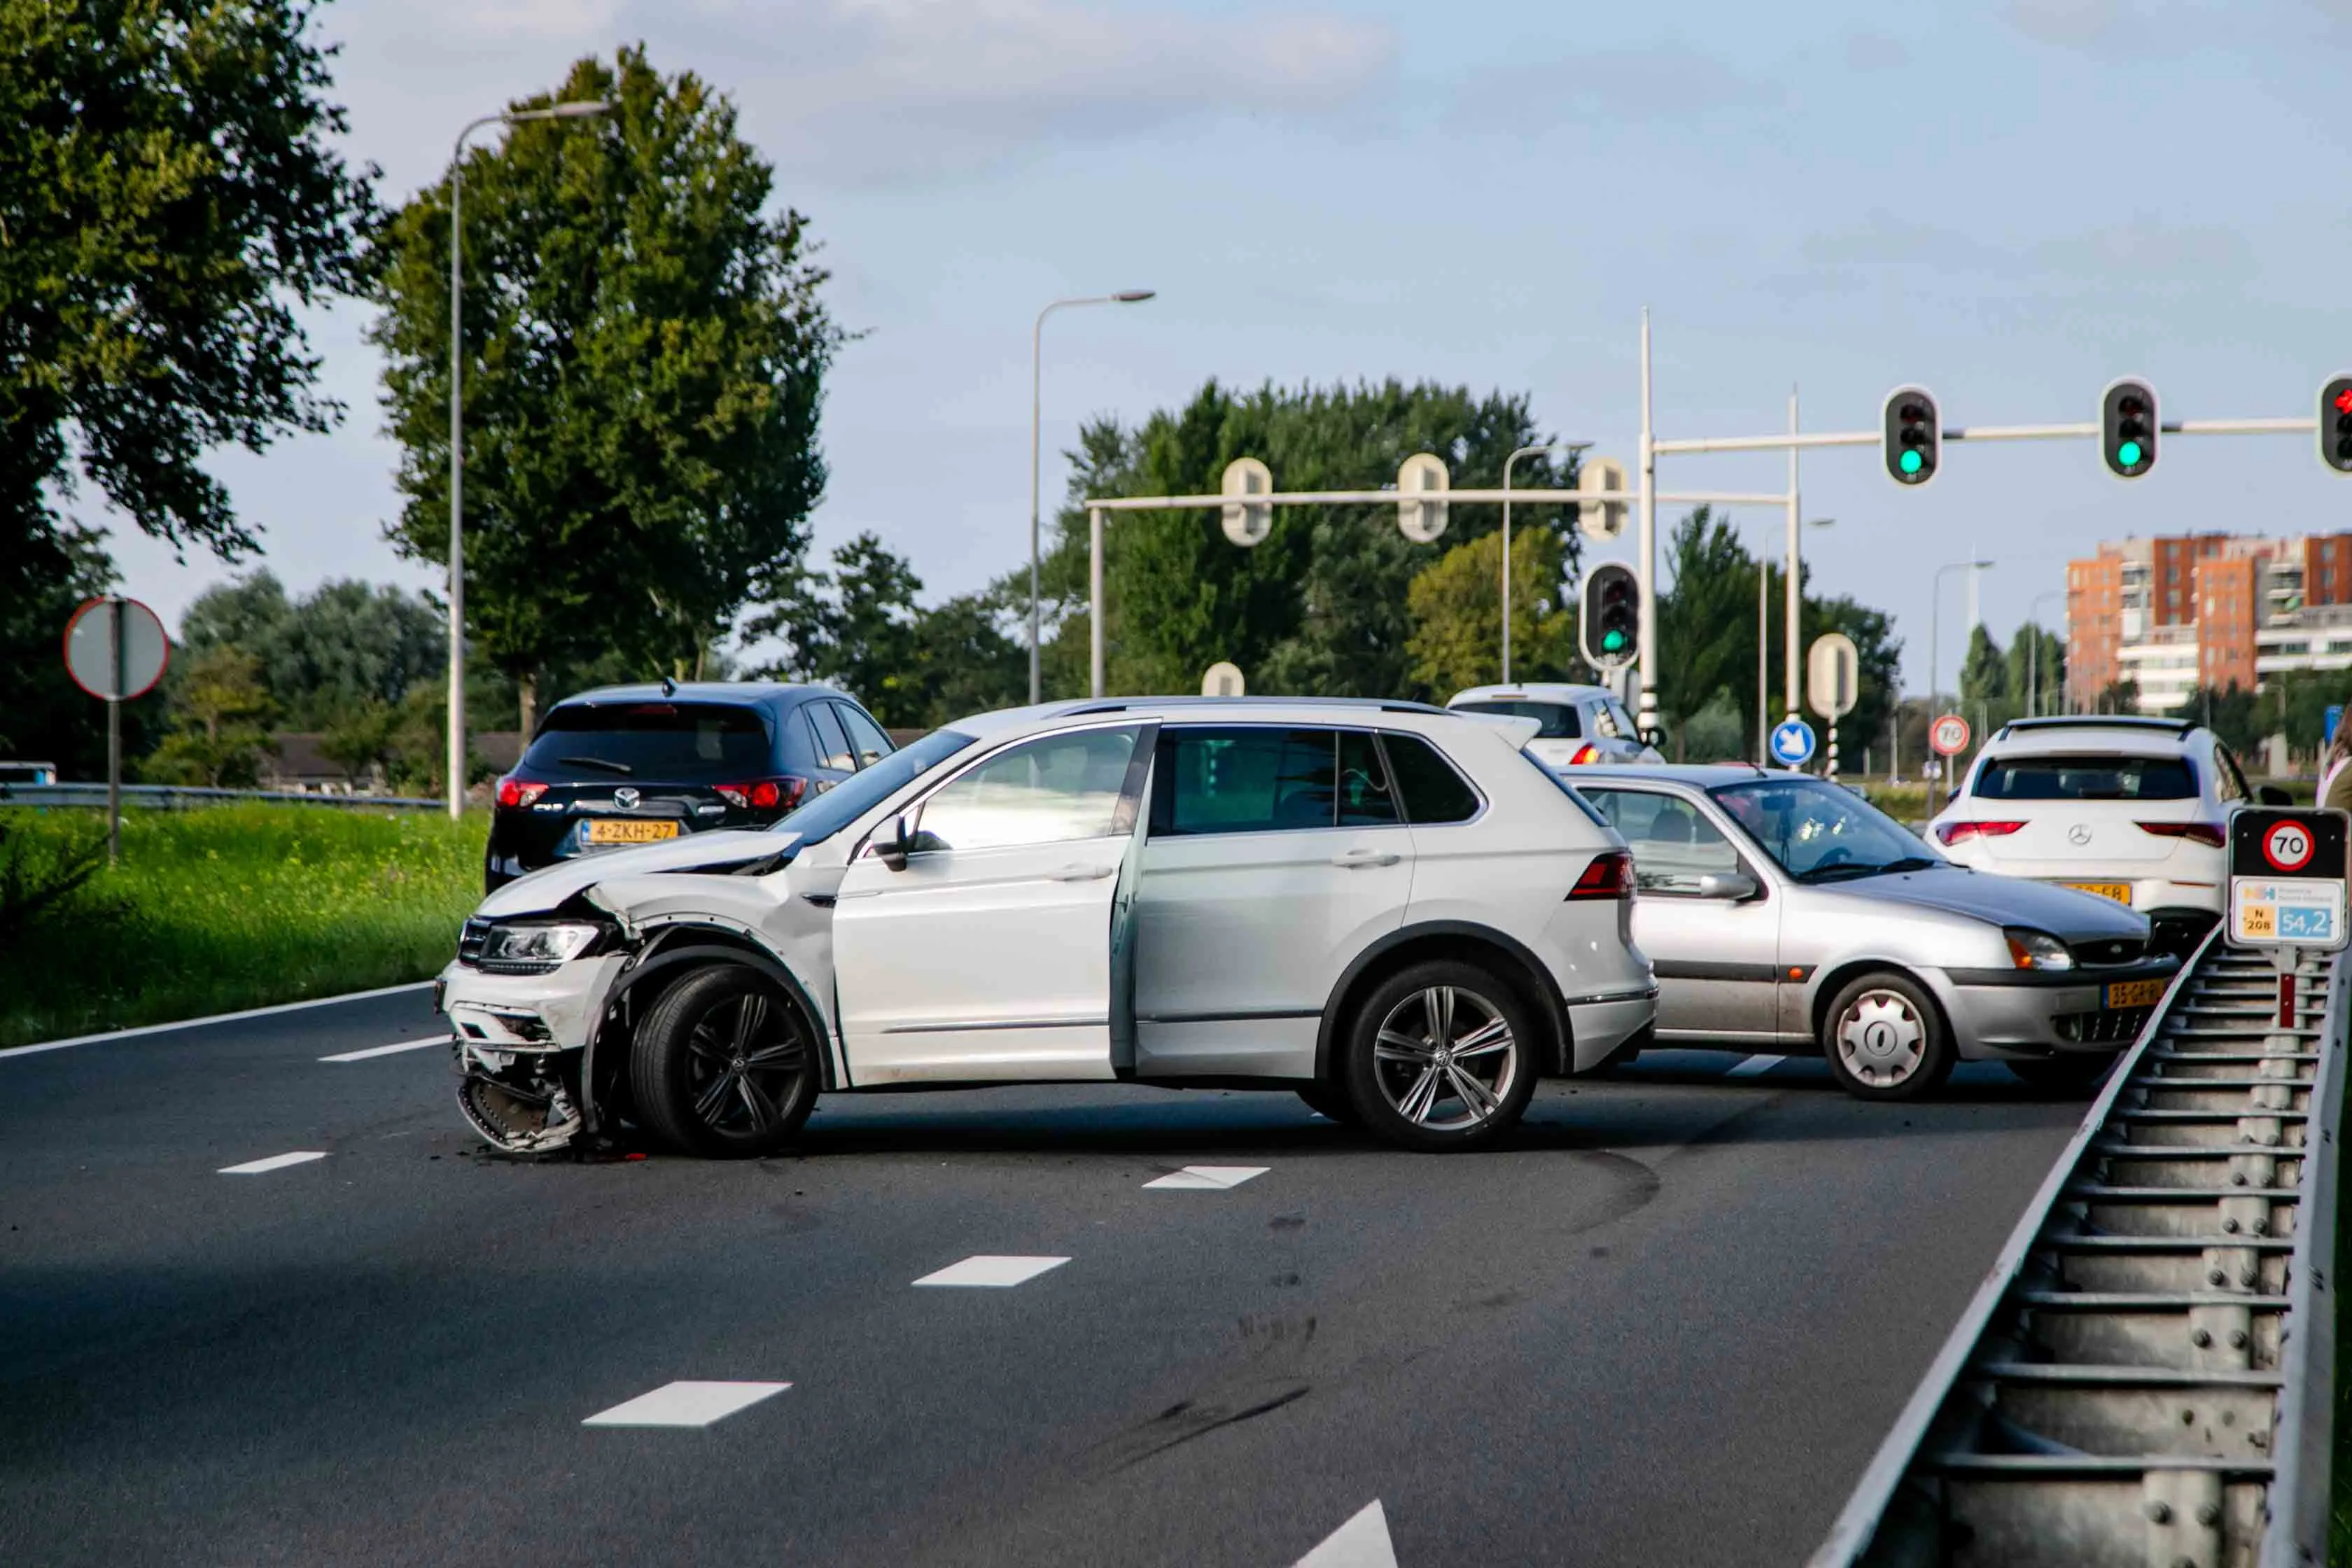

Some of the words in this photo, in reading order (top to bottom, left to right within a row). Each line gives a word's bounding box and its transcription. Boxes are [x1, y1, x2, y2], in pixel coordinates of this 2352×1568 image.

[1942, 726, 1963, 741] 70
[596, 823, 673, 839] 4-ZKH-27
[2274, 836, 2304, 854] 70
[2255, 909, 2263, 918] N
[2248, 921, 2271, 931] 208
[2282, 911, 2328, 935] 54,2
